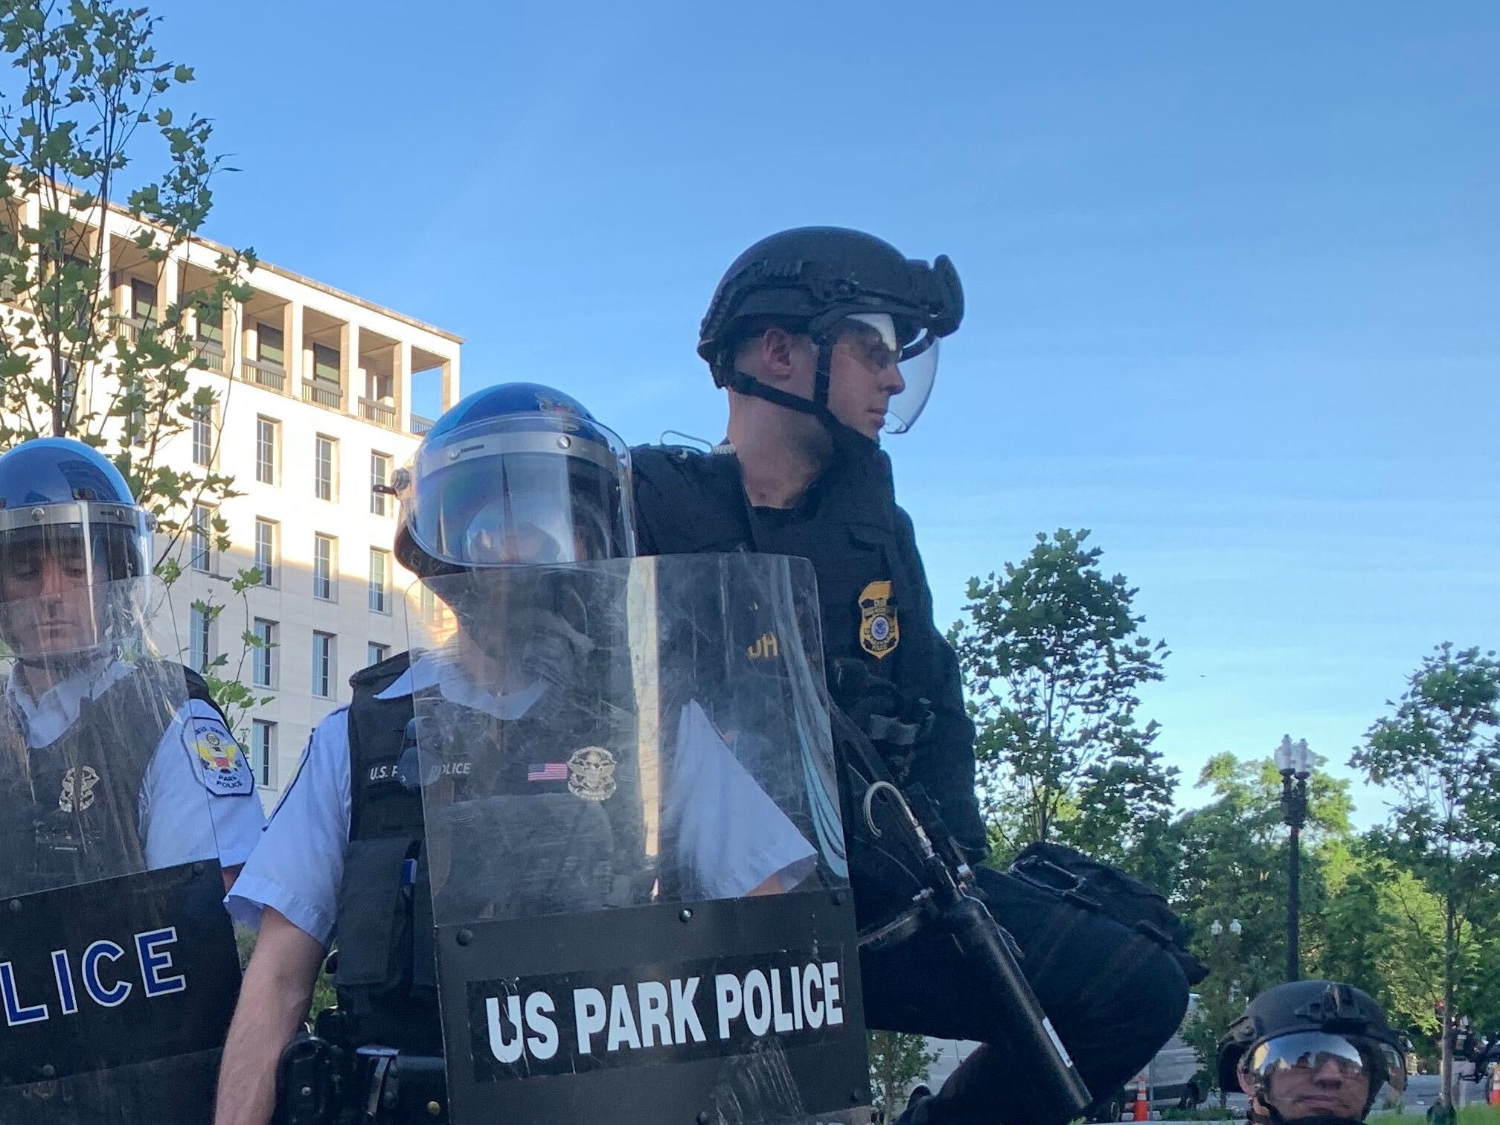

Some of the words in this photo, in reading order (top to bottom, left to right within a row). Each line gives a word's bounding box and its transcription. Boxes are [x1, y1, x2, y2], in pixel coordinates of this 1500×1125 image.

[370, 766, 388, 780] U.S.
[486, 991, 559, 1063] US
[573, 977, 706, 1055] PARK
[715, 961, 843, 1039] POLICE
